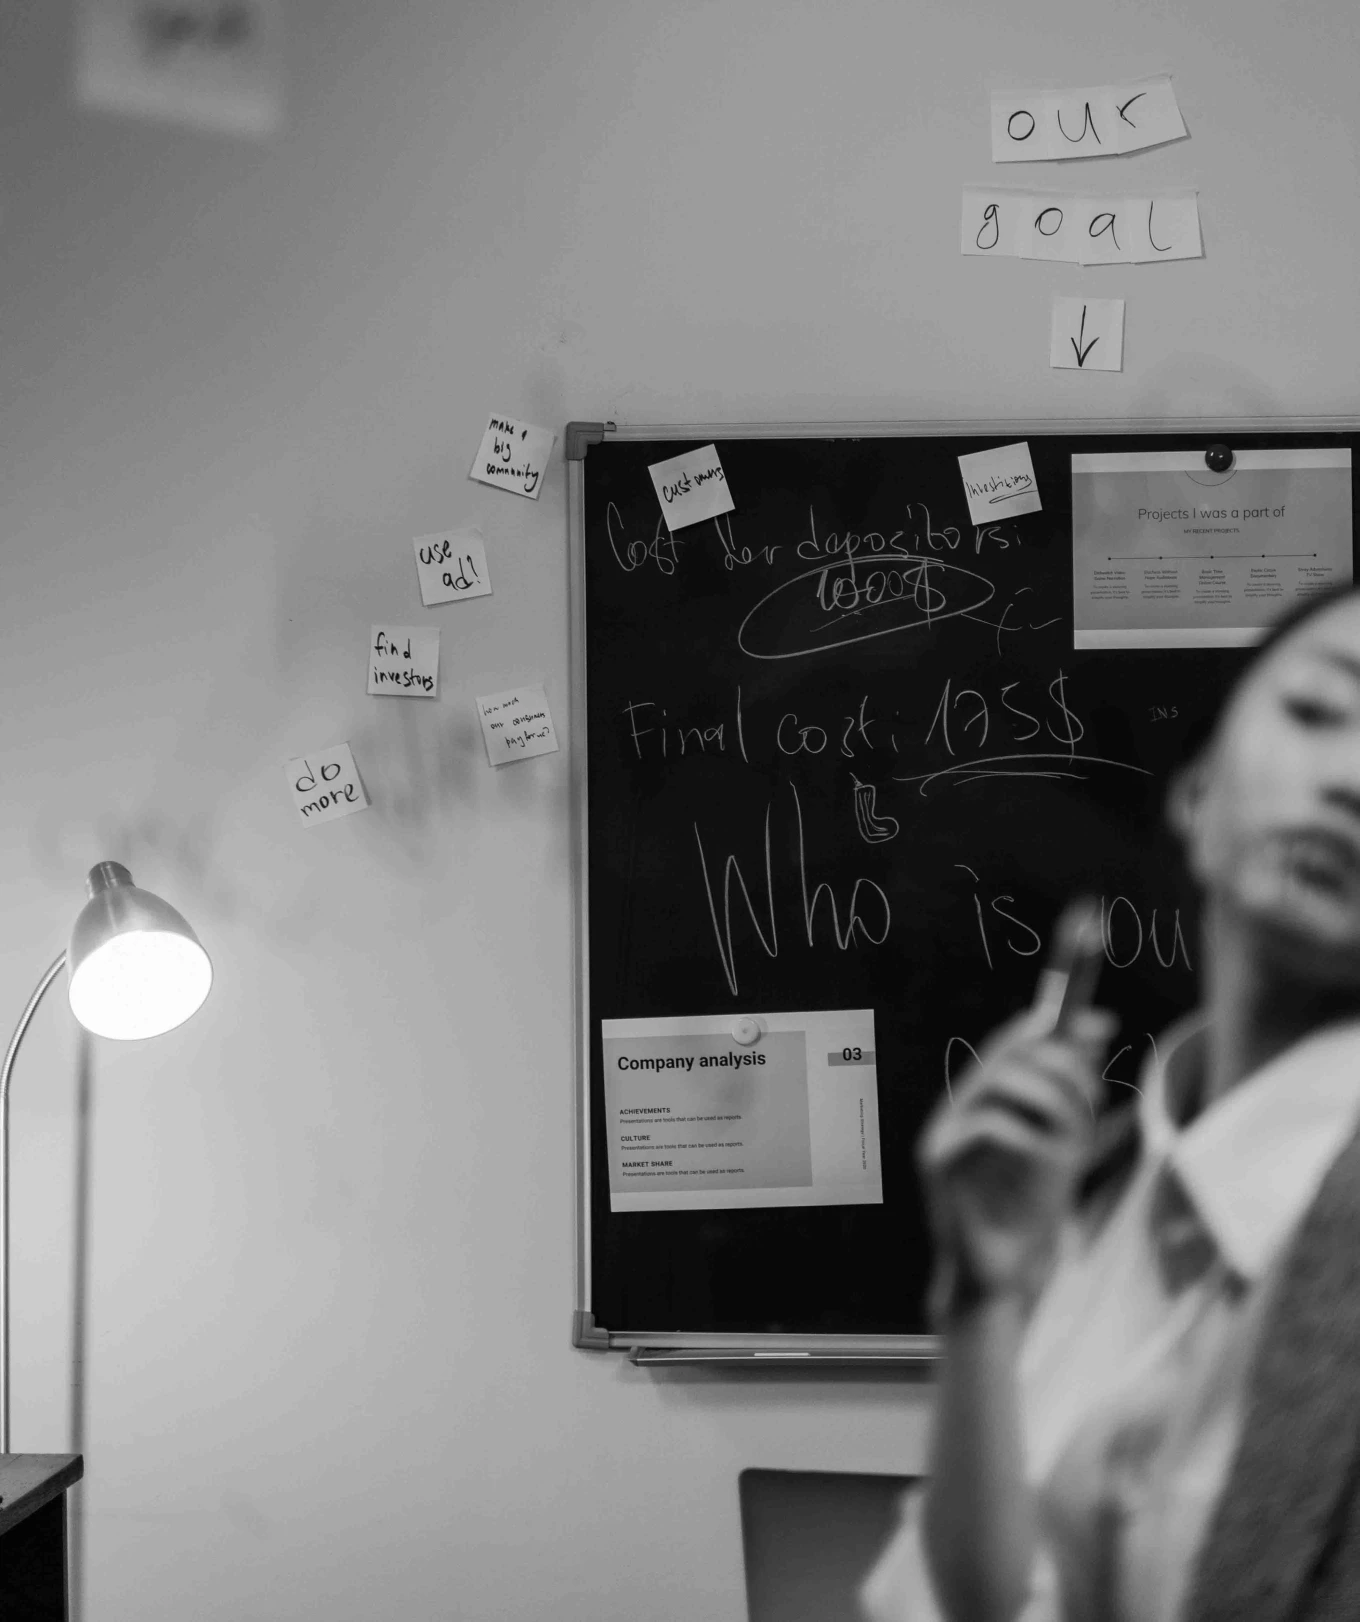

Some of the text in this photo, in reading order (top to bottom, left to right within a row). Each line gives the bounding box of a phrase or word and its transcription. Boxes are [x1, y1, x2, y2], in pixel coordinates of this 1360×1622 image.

[1007, 93, 1147, 145] our
[976, 200, 1172, 252] goal
[493, 436, 511, 463] big
[1138, 508, 1189, 523] Projects
[1200, 508, 1228, 519] was
[1231, 508, 1239, 519] a
[1243, 506, 1270, 521] part
[1273, 505, 1286, 518] of
[1192, 527, 1213, 535] RECENT
[1213, 527, 1240, 535] PROJECTS
[419, 540, 452, 565] use
[374, 631, 412, 660] find
[622, 685, 748, 763] Final
[295, 759, 341, 792] do
[300, 783, 360, 817] more
[695, 781, 890, 996] Who
[953, 864, 1041, 970] is
[617, 1051, 766, 1073] Company analysis
[842, 1047, 863, 1062] 03
[620, 1107, 671, 1115] ACHIEVEMENTS
